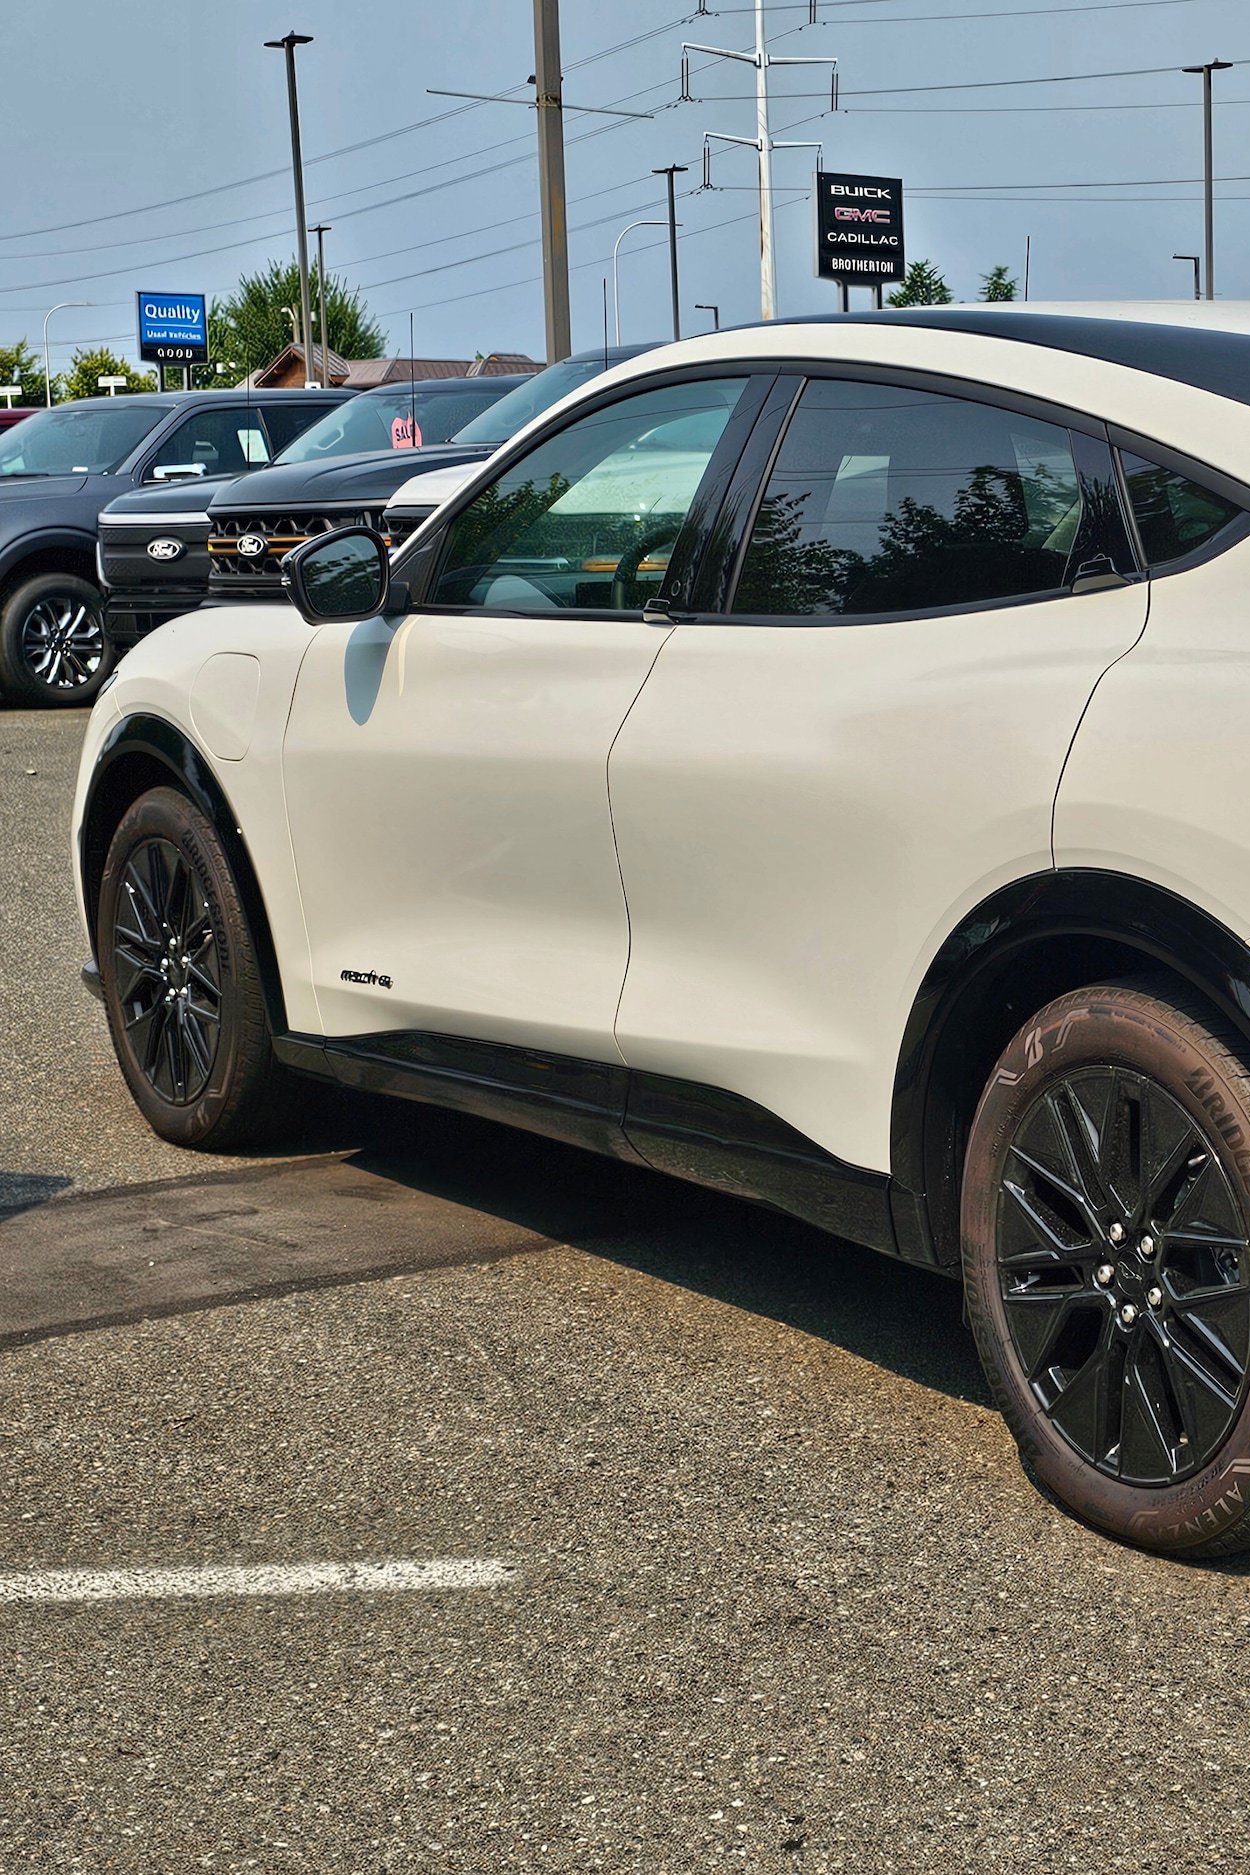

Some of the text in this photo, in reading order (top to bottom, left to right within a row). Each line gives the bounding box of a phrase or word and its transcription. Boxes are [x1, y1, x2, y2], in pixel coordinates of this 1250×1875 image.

[830, 184, 892, 200] BUICK
[834, 206, 891, 224] GMC
[827, 231, 899, 246] CADILLAC
[831, 257, 894, 274] BROTHERTON
[144, 303, 201, 324] Quality
[146, 330, 167, 338] Used
